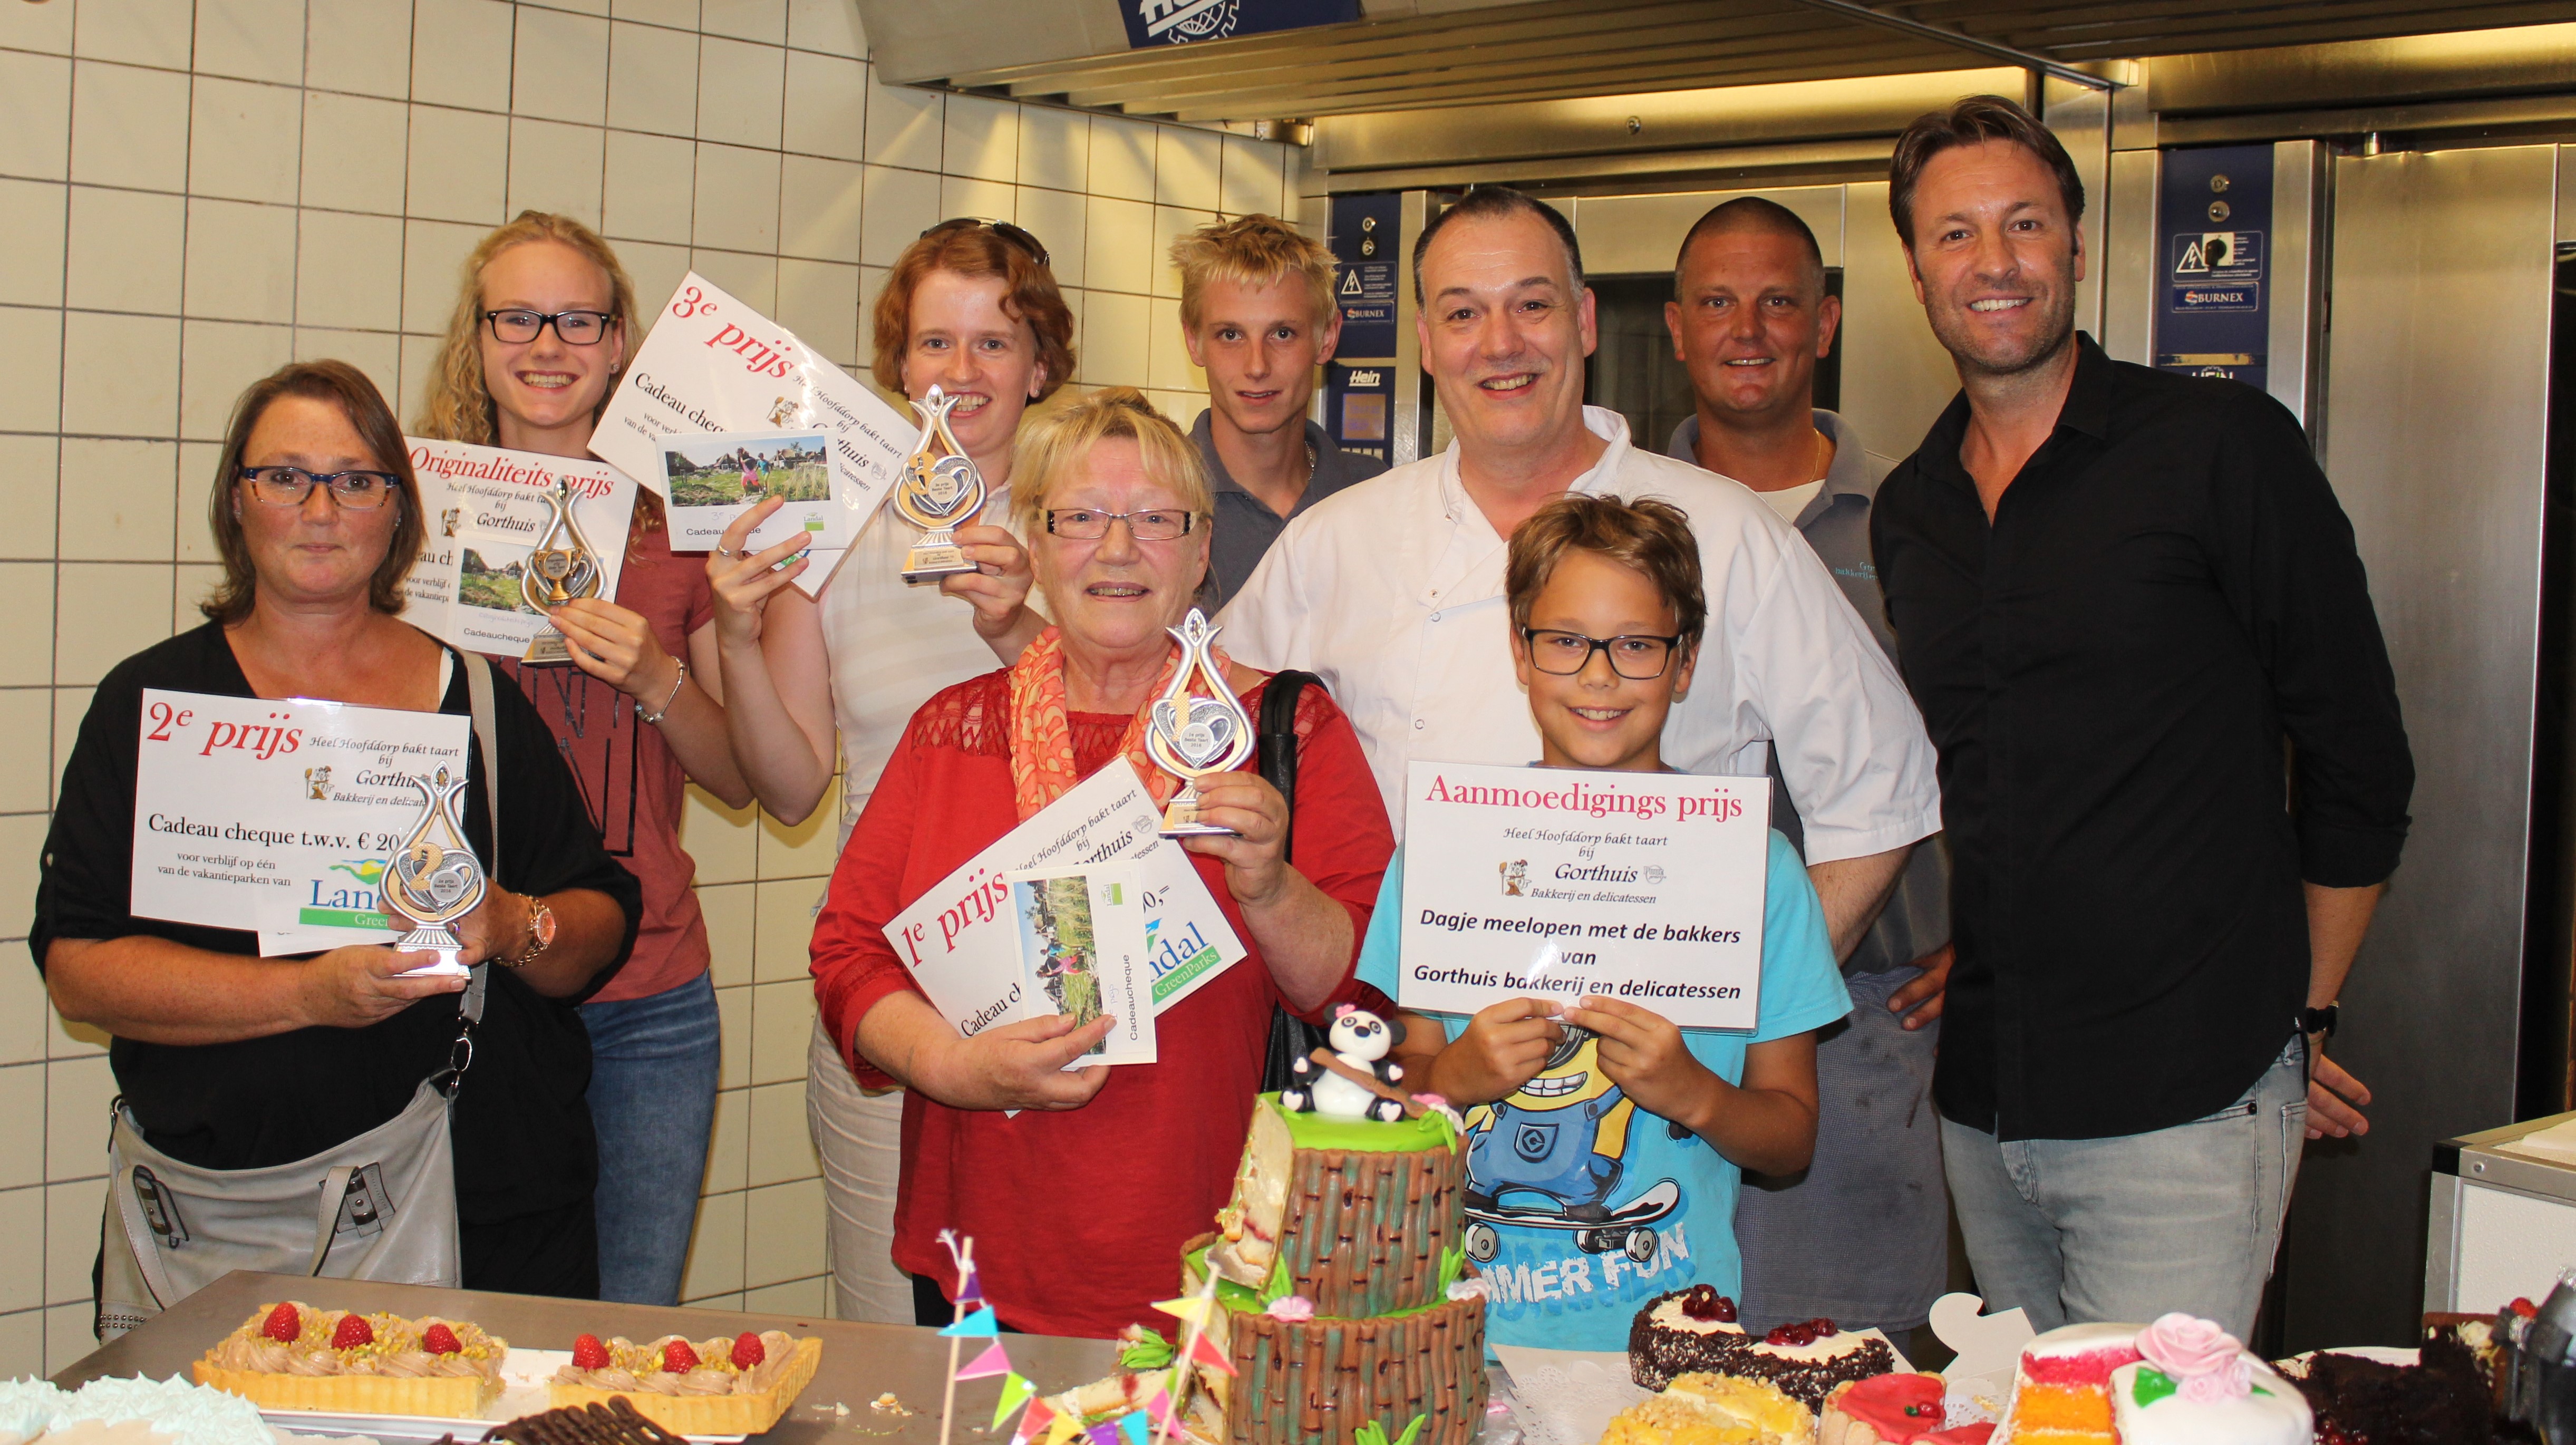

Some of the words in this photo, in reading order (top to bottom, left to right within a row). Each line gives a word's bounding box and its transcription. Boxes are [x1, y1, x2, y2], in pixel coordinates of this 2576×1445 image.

[2199, 293, 2243, 303] BURNEX
[703, 322, 795, 377] prijs
[1350, 370, 1381, 384] Hein
[635, 372, 687, 414] Cadeau
[624, 416, 637, 429] van
[637, 424, 648, 435] de
[644, 412, 662, 428] voor
[793, 375, 818, 392] Hel
[815, 390, 860, 426] Hoofddorp
[859, 423, 880, 441] bakt
[879, 439, 904, 458] taart
[837, 420, 850, 433] bij
[410, 447, 555, 487] Originaliteits
[447, 482, 466, 492] Heel
[466, 485, 513, 499] Hoofddorp
[514, 491, 535, 501] bakt
[495, 499, 507, 512] bij
[477, 512, 536, 532] Gorthuis
[422, 577, 446, 590] verblijf
[404, 587, 413, 596] de
[415, 589, 449, 603] vakantiep
[463, 627, 530, 644] Cadeaucheque
[199, 712, 304, 760] prijs
[309, 736, 337, 746] Heel
[338, 738, 400, 753] Hoofddorp
[402, 742, 428, 754] bakt
[430, 745, 459, 757] taart
[378, 753, 393, 768] bij
[356, 769, 418, 788] Gorthu
[333, 792, 375, 806] Bakkerij
[375, 797, 389, 805] en
[1425, 774, 1666, 820] Aanmoedigings
[1677, 788, 1742, 823] prijs
[149, 813, 219, 838] Cadeau
[225, 822, 295, 847] cheque
[302, 830, 350, 848] t.w.v.
[358, 832, 370, 850] €
[1037, 824, 1087, 862] Hoofddorp
[1088, 808, 1111, 828] bakt
[1111, 789, 1137, 811] taart
[1076, 836, 1090, 852] bij
[1503, 827, 1535, 840] Heel
[1535, 829, 1602, 847] Hoofddorp
[1605, 832, 1633, 845] bakt
[1635, 835, 1668, 846] taart
[177, 852, 200, 862] voor
[202, 855, 239, 868] verblijf
[240, 859, 254, 869] op
[256, 859, 276, 869] één
[1578, 846, 1595, 861] bij
[158, 866, 175, 875] van
[177, 866, 190, 876] de
[192, 868, 270, 885] vakantieparken
[273, 878, 291, 886] van
[1555, 862, 1639, 883] Gorthuis
[1531, 888, 1576, 903] Bakkerij
[1593, 891, 1657, 904] delicatessen
[936, 868, 1009, 954] prijs
[1420, 909, 1478, 932] Dagje
[1483, 916, 1582, 938] meelopen
[1587, 924, 1628, 939] met
[1633, 923, 1658, 940] de
[1663, 924, 1741, 943] bakkers
[1149, 920, 1209, 983] ndal
[1560, 951, 1596, 965] van
[1155, 951, 1217, 996] GreenParks
[1414, 965, 1498, 987] Gorthuis
[1503, 971, 1585, 996] bakkerij
[1589, 981, 1614, 994] en
[1619, 979, 1741, 999] delicatessen
[1123, 954, 1138, 1041] Cadeaucheque
[961, 998, 1009, 1037] Cadeau
[1602, 1221, 1690, 1291] FUN
